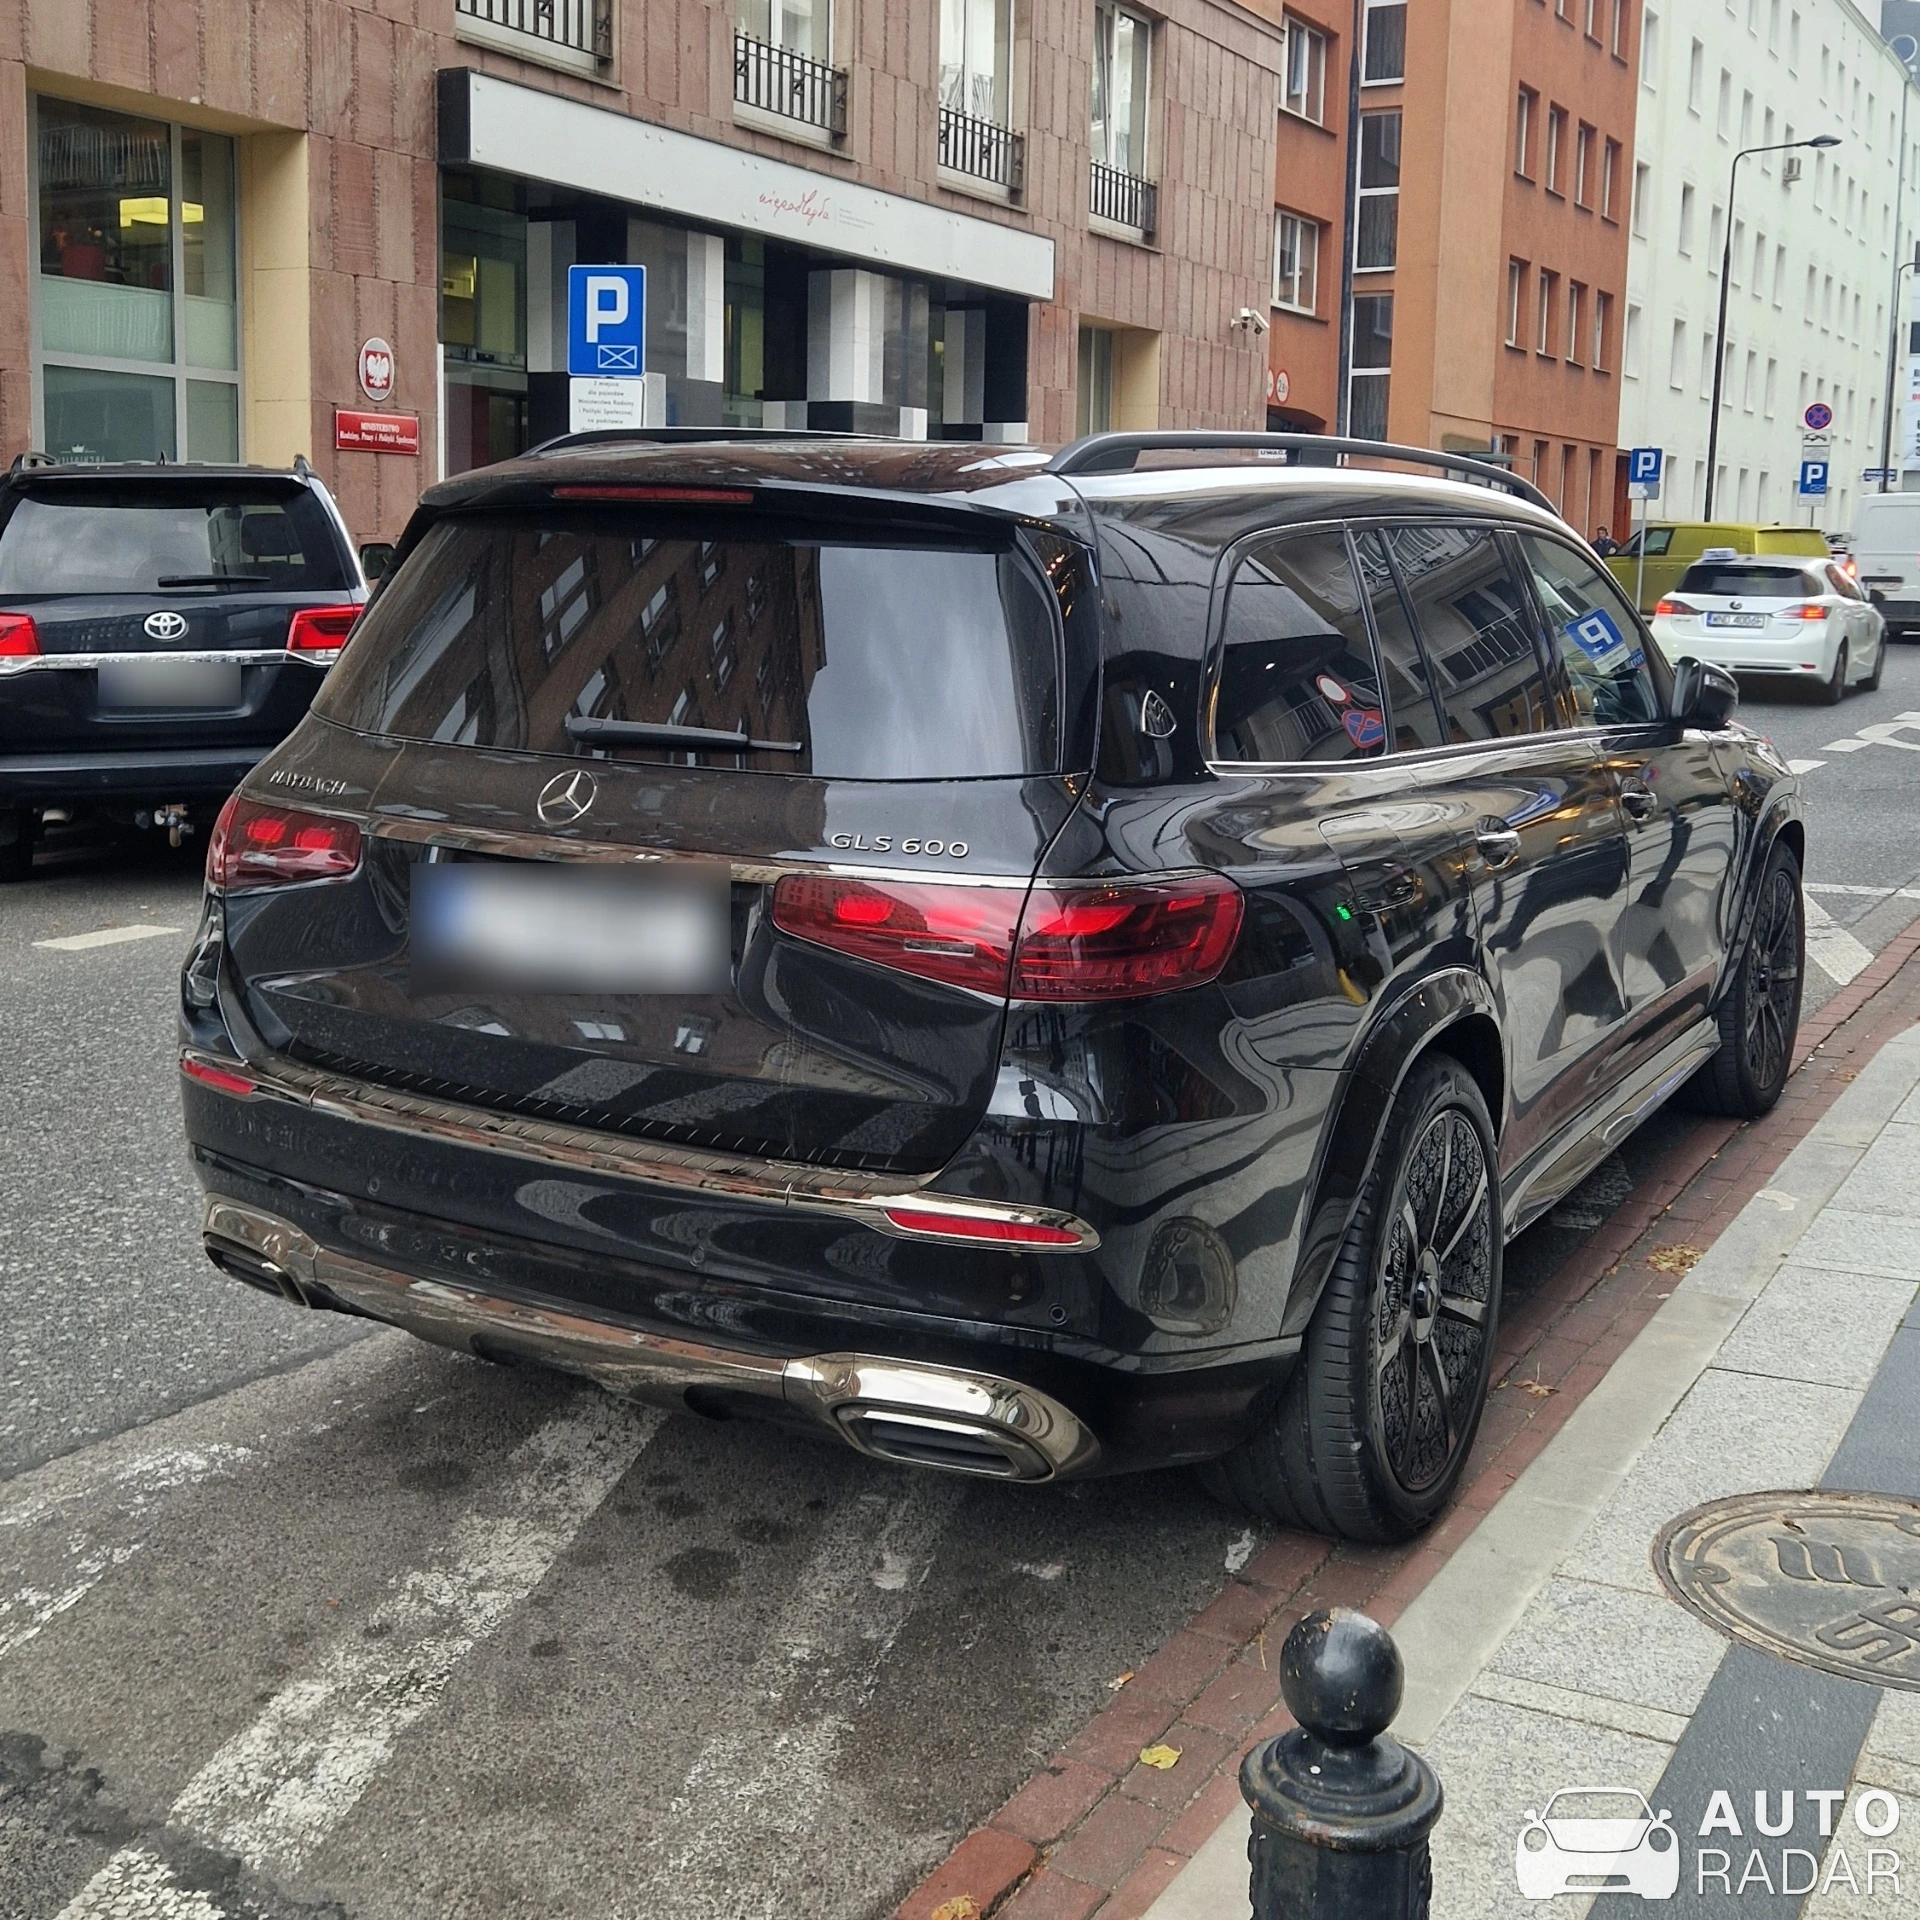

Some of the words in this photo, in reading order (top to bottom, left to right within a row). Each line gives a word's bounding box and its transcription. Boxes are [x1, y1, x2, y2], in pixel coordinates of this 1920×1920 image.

[586, 276, 628, 343] P
[1637, 452, 1656, 478] P
[1806, 464, 1824, 485] P
[269, 769, 347, 795] MAYBACH
[830, 832, 892, 852] GLS
[901, 838, 969, 858] 600
